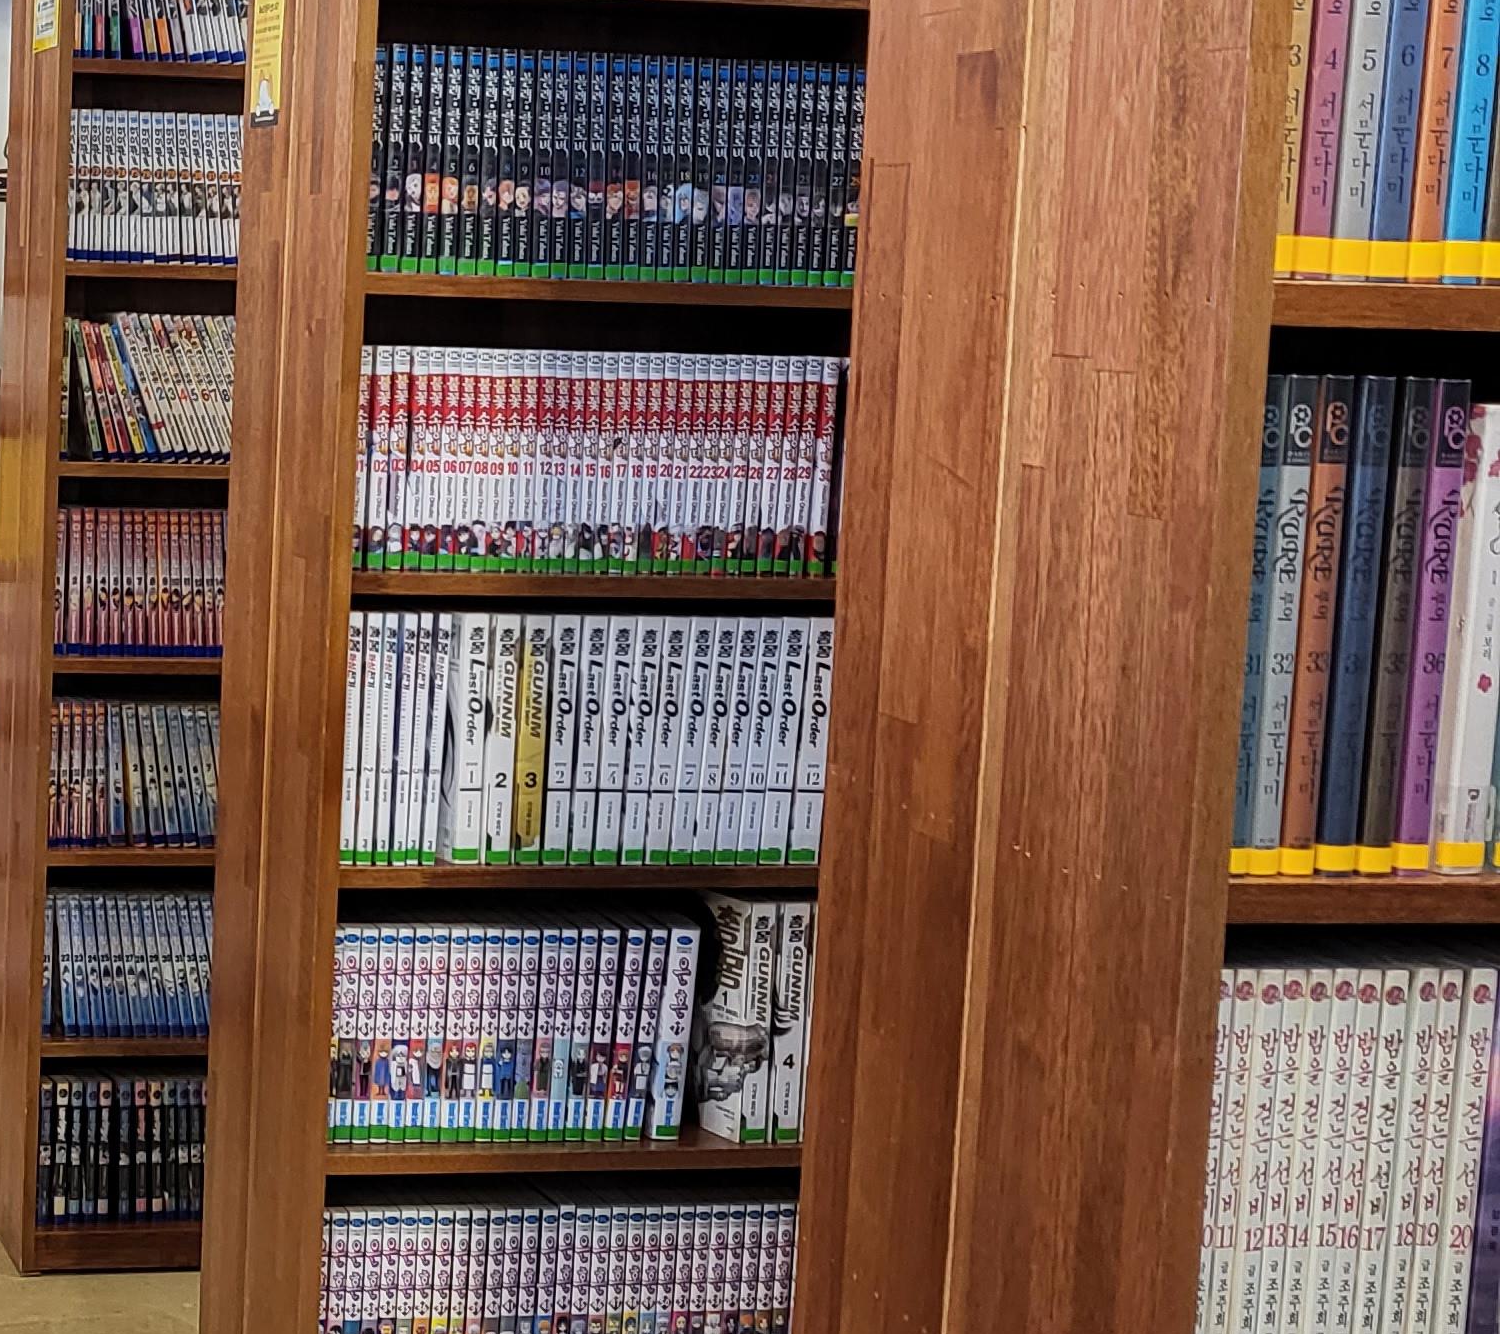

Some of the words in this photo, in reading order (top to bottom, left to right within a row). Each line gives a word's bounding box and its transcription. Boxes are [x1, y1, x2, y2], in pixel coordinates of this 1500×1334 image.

[1289, 44, 1301, 67] 3
[1325, 48, 1337, 70] 4
[1363, 49, 1376, 71] 5
[1402, 45, 1415, 67] 6
[1442, 47, 1454, 68] 7
[1477, 54, 1490, 76] 8
[539, 166, 550, 176] 10
[179, 389, 188, 401] 4
[222, 389, 230, 402] 8
[426, 461, 440, 473] 05
[508, 462, 518, 475] 10
[660, 464, 673, 477] 20
[766, 466, 779, 480] 27
[1271, 653, 1294, 676] 32
[1423, 652, 1446, 674] 36
[468, 658, 485, 700] Last
[557, 659, 575, 700] Last
[639, 661, 657, 699] Last
[737, 661, 754, 700] Last
[813, 661, 831, 700] Last
[500, 660, 515, 739] GUNNM
[530, 660, 545, 739] GUNNM
[466, 697, 483, 746] Order
[555, 697, 573, 747] Order
[634, 699, 653, 748] Order
[731, 699, 749, 748] Order
[809, 699, 827, 748] Order
[469, 770, 474, 784] 1
[494, 772, 507, 789] 2
[524, 772, 537, 788] 3
[555, 771, 565, 784] 2
[633, 772, 643, 786] 5
[730, 772, 739, 786] 9
[806, 772, 820, 786] 12
[788, 946, 804, 1022] GUNNM
[783, 1053, 794, 1069] 4
[1229, 1024, 1252, 1085] 밤을
[1278, 1023, 1302, 1085] 밤을
[1329, 1024, 1354, 1085] 밤을
[1410, 1024, 1434, 1086] 밤을
[1466, 1027, 1491, 1088] 밤을
[1223, 1093, 1246, 1150] 걷는
[1272, 1093, 1295, 1149] 걷는
[1324, 1093, 1346, 1149] 걷는
[1404, 1093, 1428, 1150] 걷는
[1458, 1095, 1483, 1152] 걷는
[1222, 1157, 1241, 1218] 선비
[1271, 1156, 1291, 1218] 선비
[1322, 1156, 1342, 1217] 선비
[1401, 1156, 1421, 1217] 선비
[1456, 1158, 1478, 1219] 선비
[1215, 1224, 1234, 1248] 11
[1244, 1227, 1264, 1252] 12
[1267, 1223, 1288, 1248] 13
[1287, 1224, 1309, 1248] 14
[1316, 1223, 1337, 1247] 15
[1337, 1224, 1359, 1249] 16
[1362, 1226, 1386, 1251] 17
[1394, 1222, 1415, 1247] 18
[1416, 1222, 1439, 1247] 19
[1449, 1224, 1473, 1249] 20
